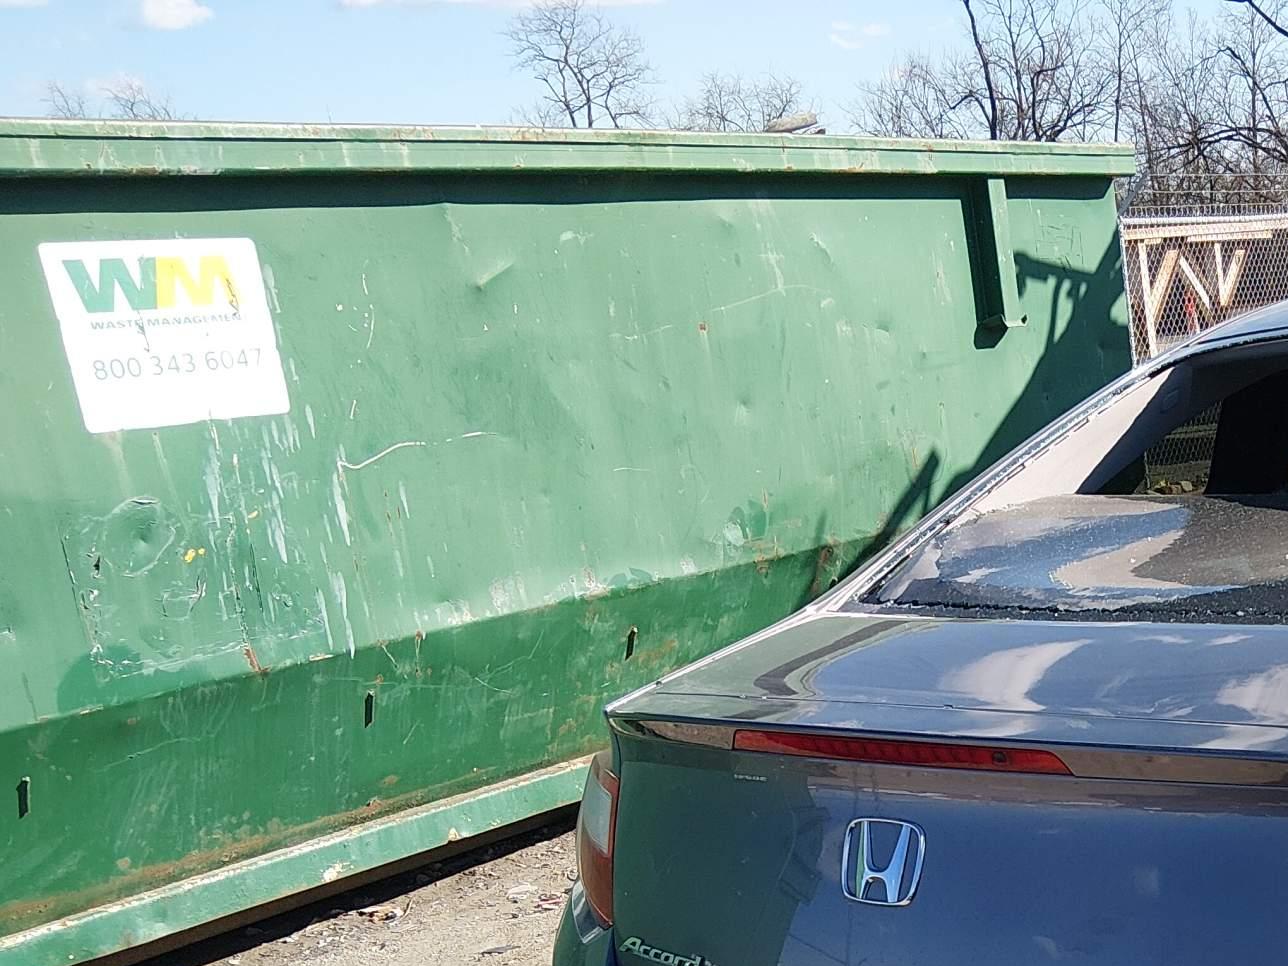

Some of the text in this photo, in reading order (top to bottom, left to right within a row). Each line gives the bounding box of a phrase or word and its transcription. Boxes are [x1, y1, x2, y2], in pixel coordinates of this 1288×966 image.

[62, 255, 242, 313] WM
[147, 314, 246, 328] MANAGEMEN
[93, 348, 262, 380] 800 343 6047
